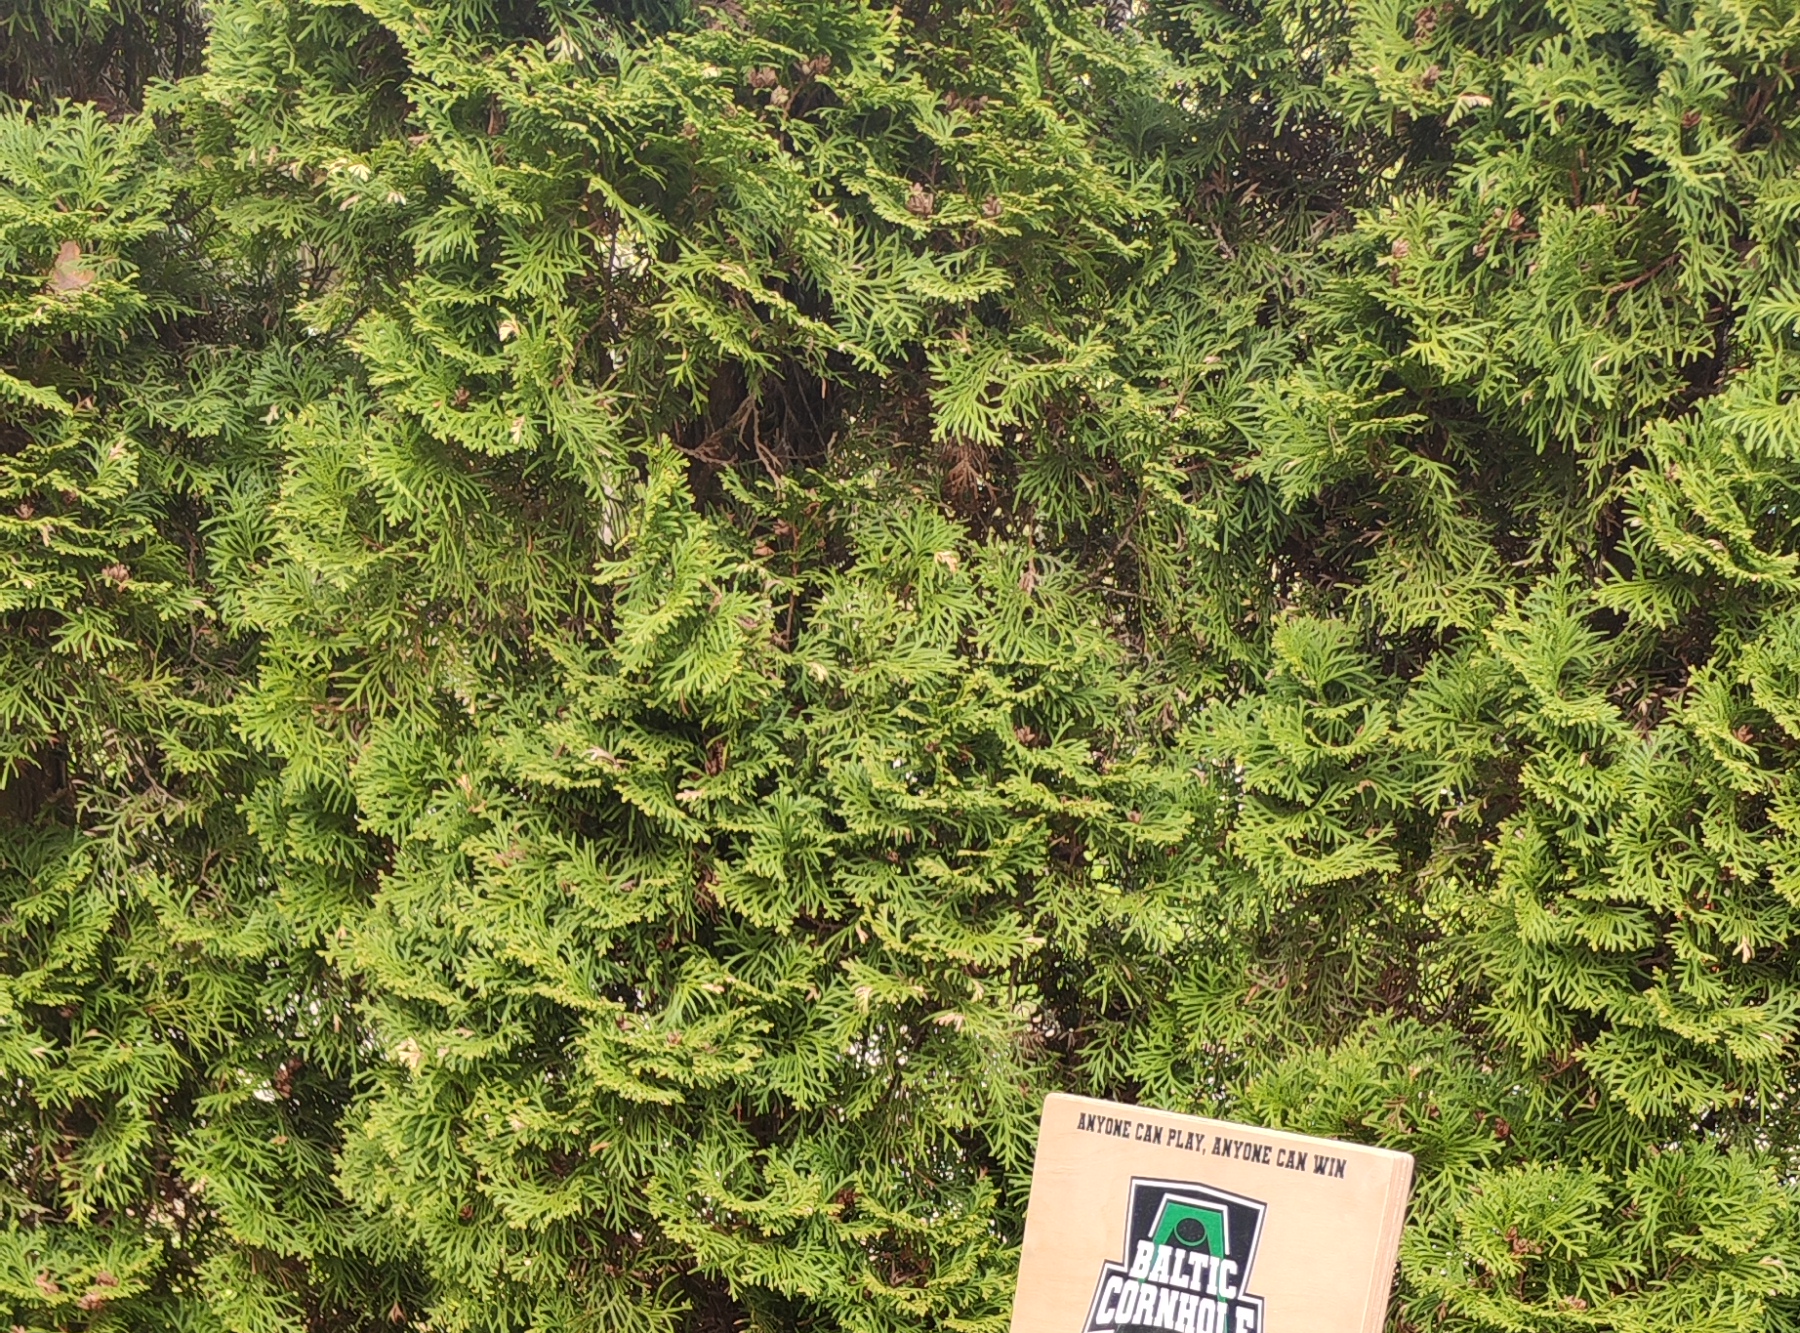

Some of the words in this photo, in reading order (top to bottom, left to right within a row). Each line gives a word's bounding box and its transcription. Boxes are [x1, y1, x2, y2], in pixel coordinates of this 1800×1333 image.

[1077, 1112, 1132, 1139] ANYONE
[1135, 1122, 1162, 1145] CAN
[1166, 1128, 1208, 1156] PLAY,
[1212, 1137, 1272, 1166] ANYONE
[1276, 1149, 1309, 1172] CAN
[1314, 1154, 1346, 1179] WIN
[1130, 1240, 1239, 1299] BALTIC
